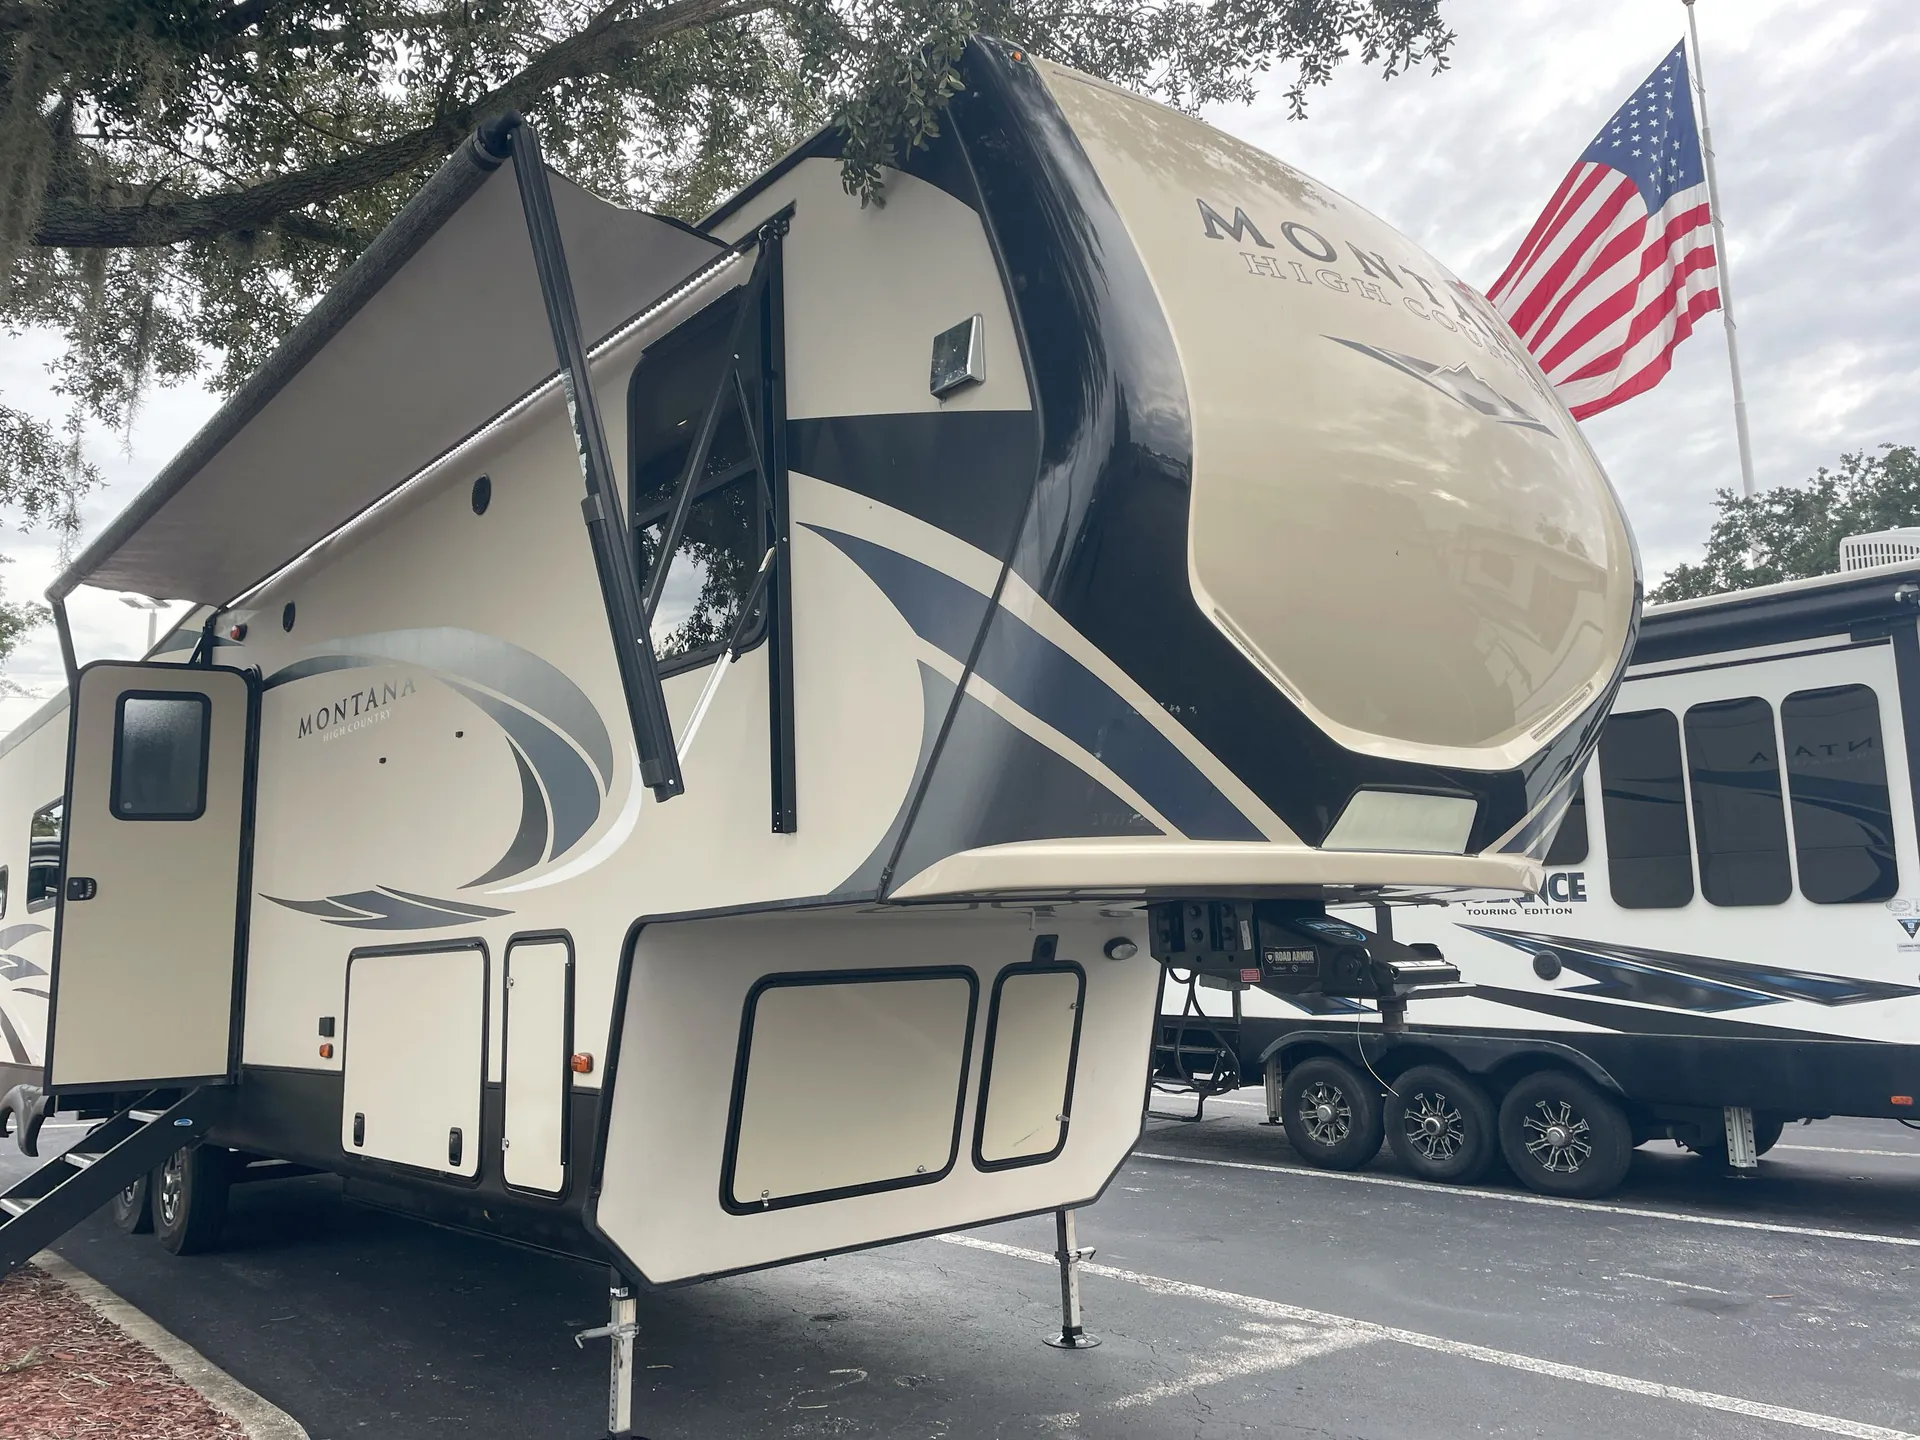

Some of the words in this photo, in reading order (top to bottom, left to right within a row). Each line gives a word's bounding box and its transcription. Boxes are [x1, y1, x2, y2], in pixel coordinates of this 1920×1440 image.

[1239, 251, 1392, 306] HIGH
[297, 677, 416, 739] MONTANA
[323, 726, 346, 742] HIGH
[347, 709, 392, 733] COUNTRY
[1466, 908, 1517, 916] TOURING
[1524, 907, 1573, 916] EDITION
[1274, 951, 1292, 962] ROAD
[1292, 950, 1315, 962] ARMOR
